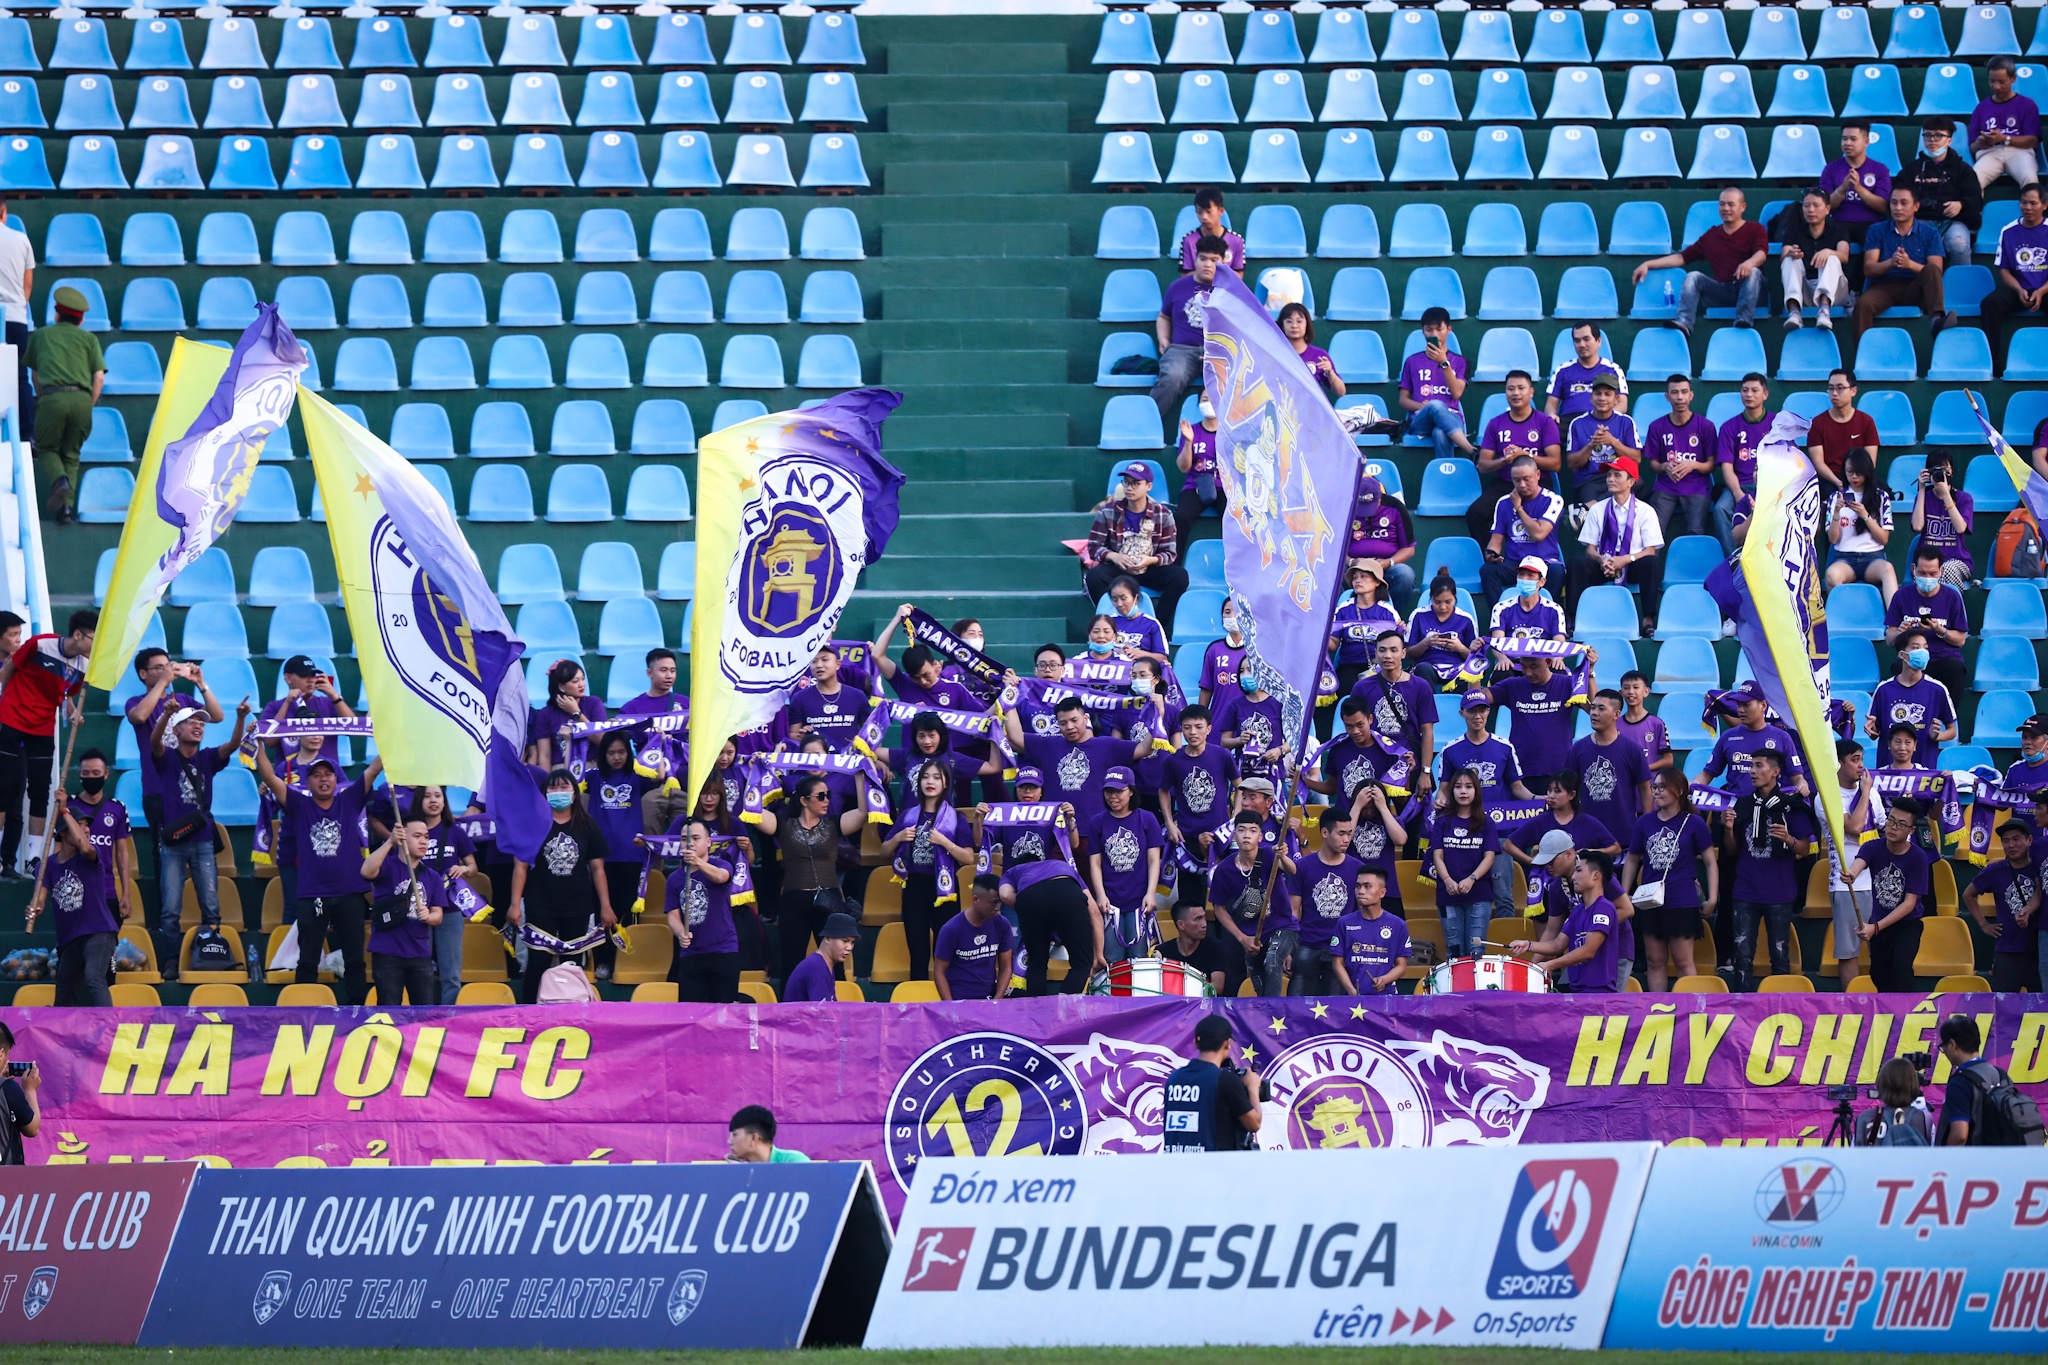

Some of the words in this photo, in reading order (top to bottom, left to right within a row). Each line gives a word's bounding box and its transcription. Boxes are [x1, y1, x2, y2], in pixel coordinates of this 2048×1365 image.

[1985, 117, 1997, 130] 12
[1418, 369, 1432, 381] 12
[1498, 430, 1511, 443] 12
[1662, 433, 1674, 446] 12
[1193, 443, 1206, 454] 12
[1676, 452, 1697, 462] SCG
[744, 466, 852, 536] HANOI
[392, 613, 409, 629] 20
[806, 605, 845, 654] CLUB
[917, 620, 980, 669] HANOI
[973, 661, 1000, 681] FC
[1490, 637, 1519, 652] HA
[1525, 639, 1569, 654] NOI
[1216, 655, 1229, 667] 12
[1081, 663, 1126, 680] NOI
[1122, 696, 1147, 710] FC
[965, 714, 992, 733] FC
[1873, 775, 1916, 793] NOI
[1918, 776, 1945, 793] FC
[1691, 790, 1722, 807] HA
[1009, 805, 1055, 821] NOI
[90, 834, 112, 847] SCG
[1565, 1003, 1734, 1087] HÃY
[98, 1012, 234, 1096] HÀ
[260, 1013, 446, 1111] NỘI
[464, 1026, 593, 1100] FC
[1270, 1048, 1380, 1108] HANOI
[896, 1043, 1063, 1138] SOUTHERN
[1168, 1084, 1201, 1102] 2020
[1397, 1099, 1412, 1112] 06
[925, 1079, 1044, 1157] 12
[1168, 1113, 1190, 1130] LS
[930, 1171, 999, 1205] Đón
[1003, 1179, 1076, 1204] xem
[1875, 1170, 2000, 1240] TẬP
[63, 1190, 151, 1251] CLUB
[208, 1196, 306, 1256] THAN
[305, 1195, 435, 1260] QUANG
[434, 1194, 541, 1256] NINH
[532, 1193, 700, 1256] FOOTBALL
[714, 1191, 811, 1253] CLUB
[1751, 1235, 1823, 1249] VINACOMIN
[977, 1223, 1397, 1291] BUNDESLIGA
[1498, 1274, 1574, 1296] SPORTS
[294, 1278, 352, 1319] ONE
[355, 1278, 427, 1319] TEAM
[450, 1278, 510, 1319] ONE
[513, 1277, 665, 1319] HEARTBEAT
[1658, 1256, 1754, 1329] CÔNG
[1747, 1257, 1877, 1342] NGHIỆP
[1873, 1268, 1968, 1330] THAN
[1313, 1307, 1384, 1340] trên
